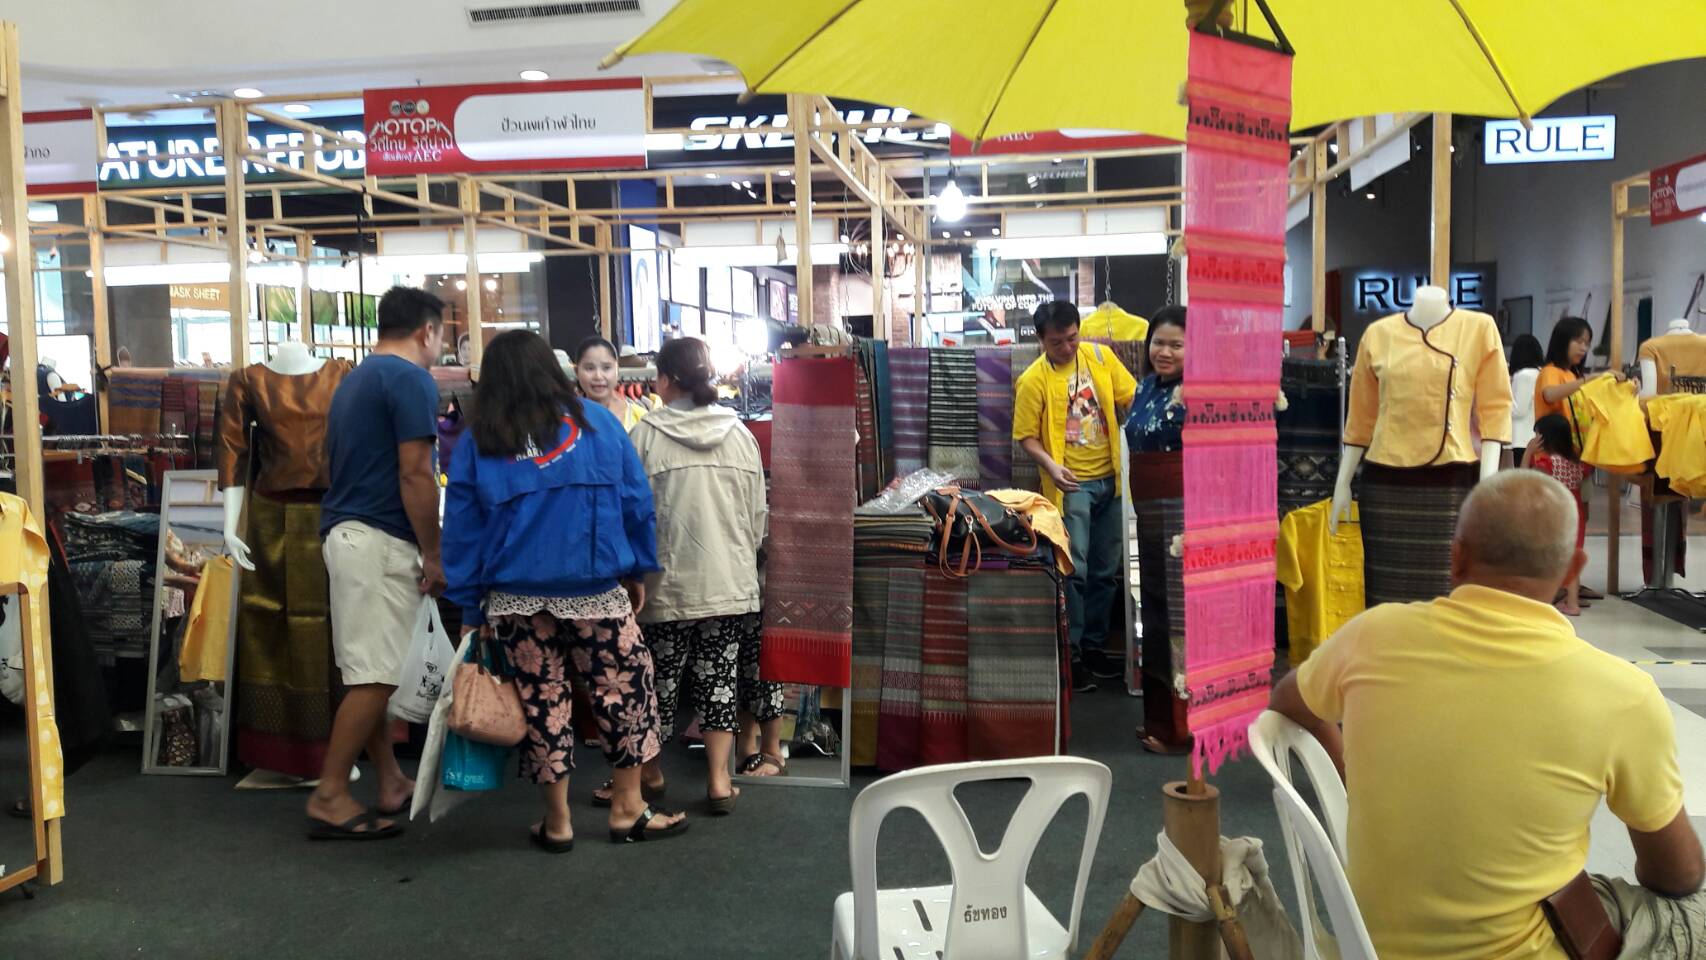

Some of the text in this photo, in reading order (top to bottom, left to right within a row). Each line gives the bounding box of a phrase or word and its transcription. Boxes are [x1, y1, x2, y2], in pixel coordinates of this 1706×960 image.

[1496, 124, 1605, 154] RULE
[98, 137, 228, 181] ATURE
[1038, 292, 1055, 303] THE
[1358, 274, 1484, 311] RUE
